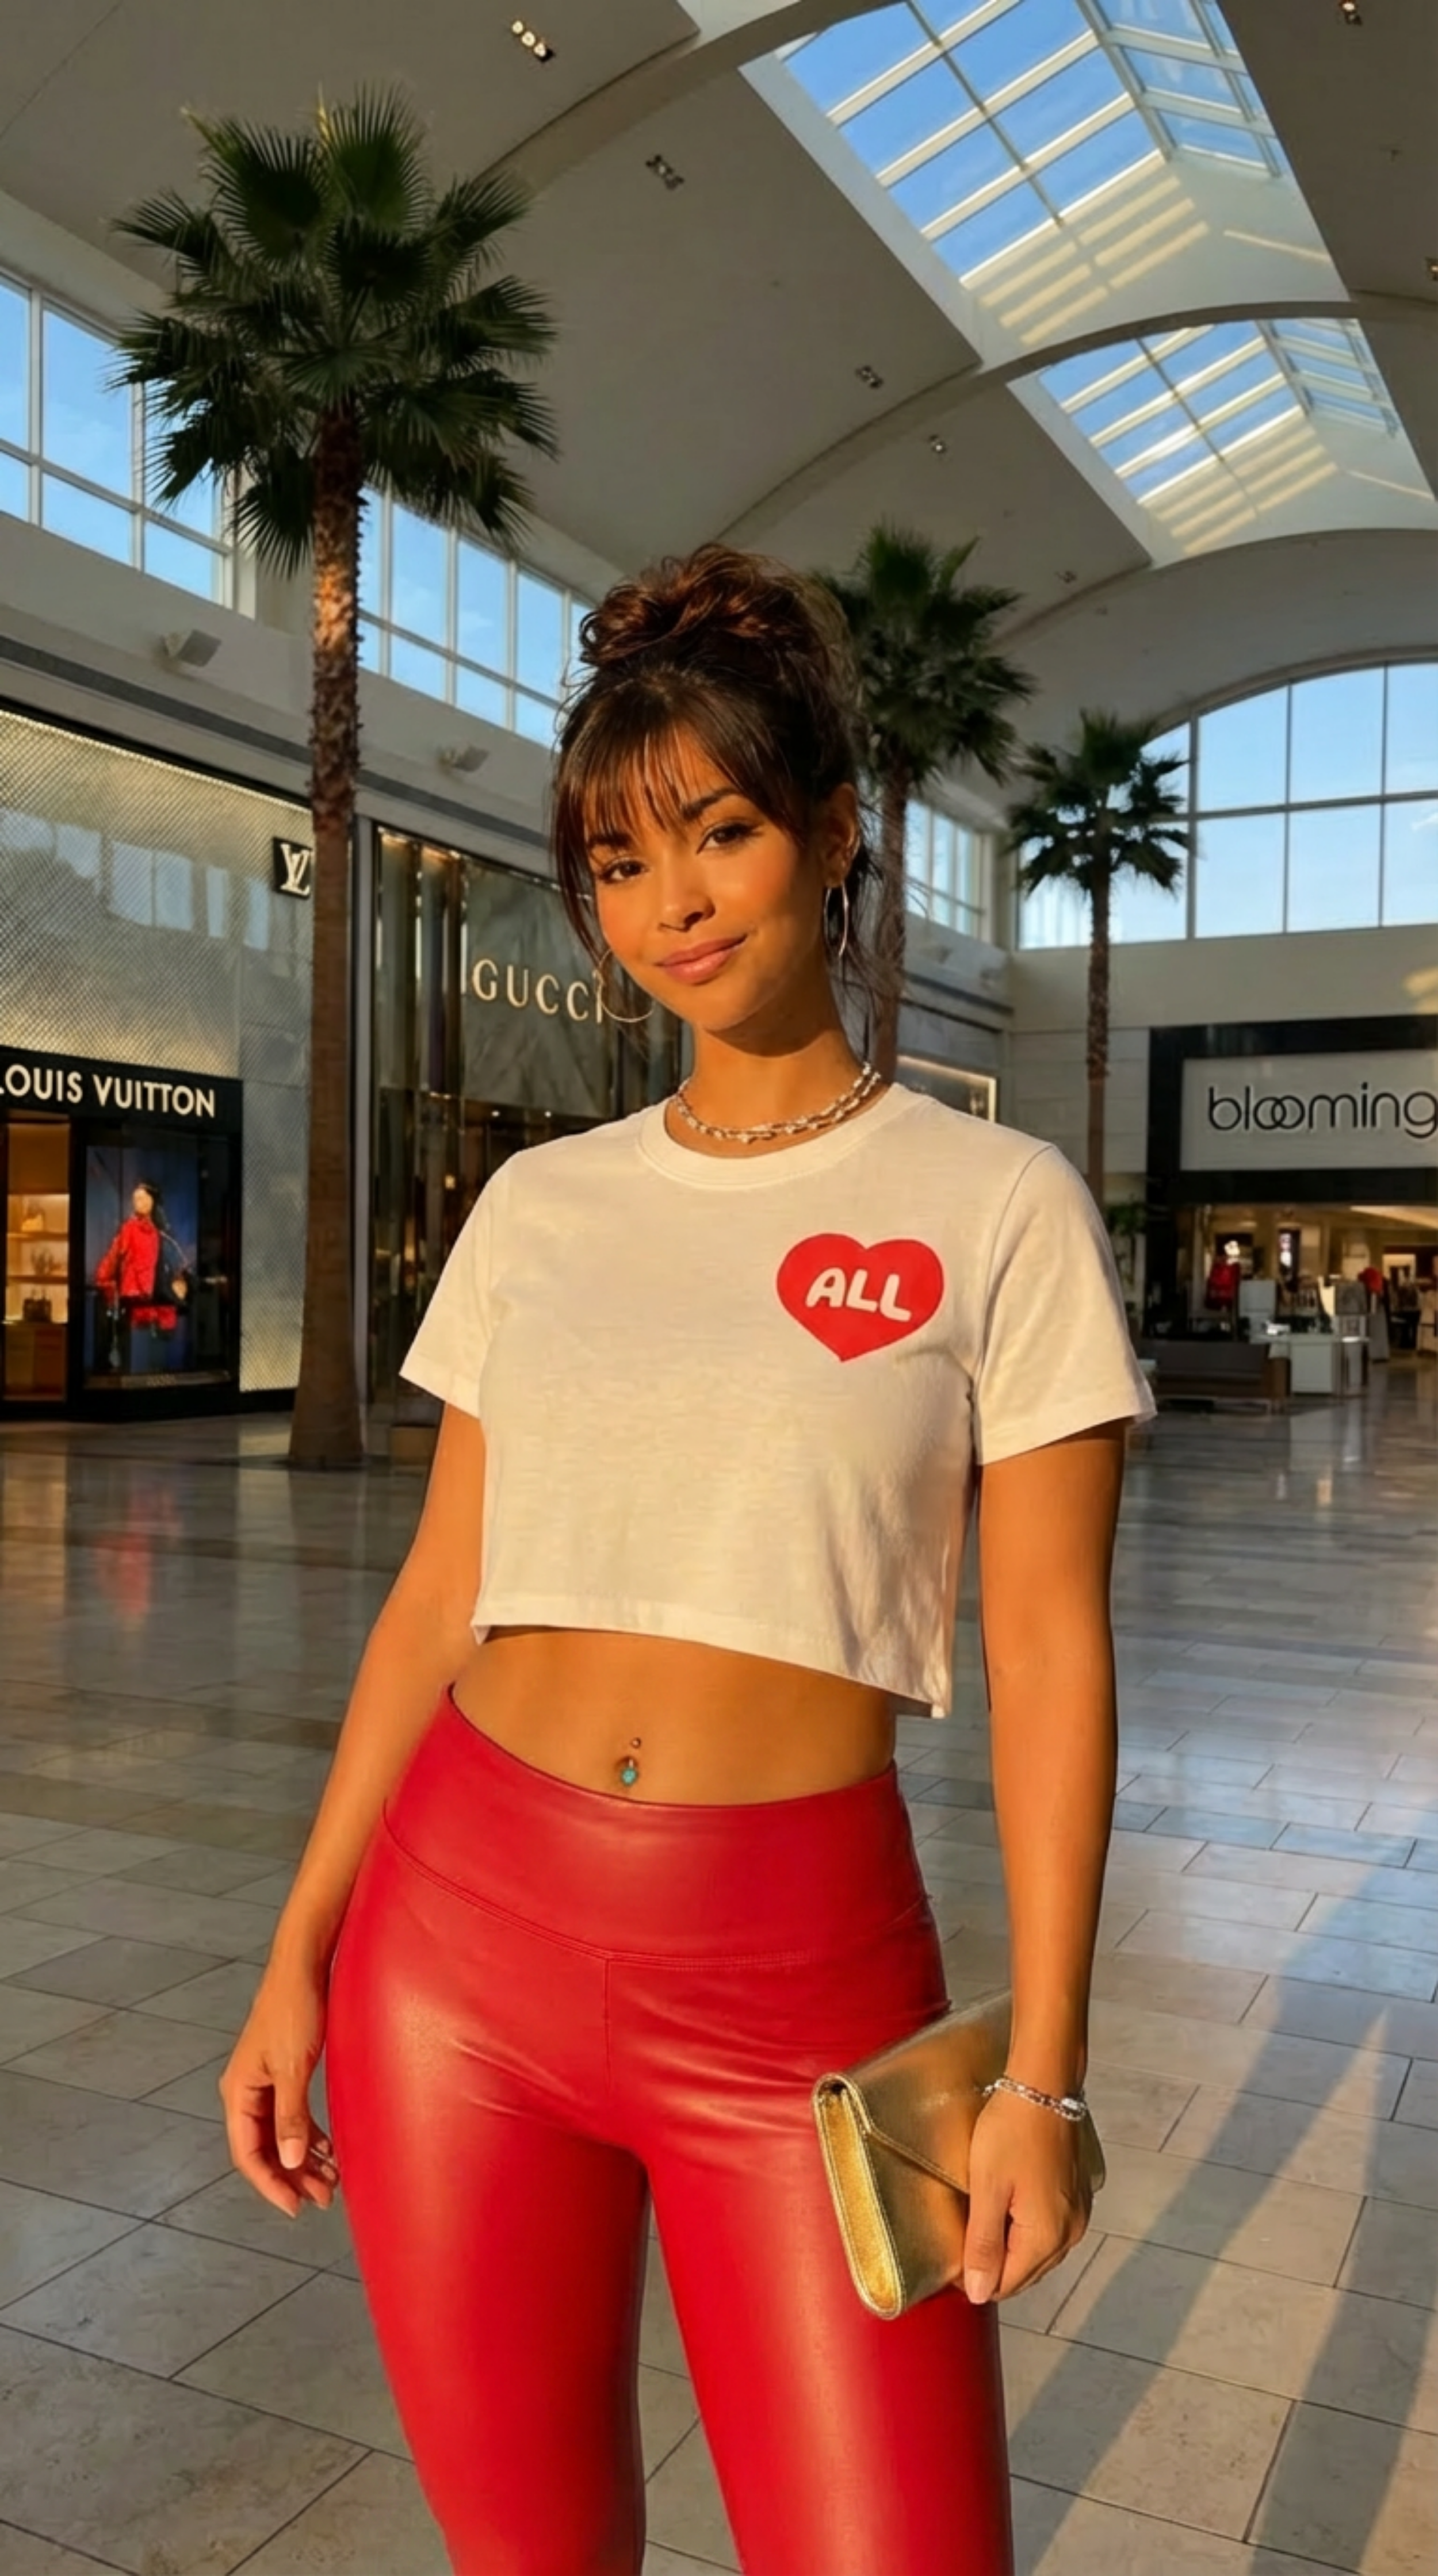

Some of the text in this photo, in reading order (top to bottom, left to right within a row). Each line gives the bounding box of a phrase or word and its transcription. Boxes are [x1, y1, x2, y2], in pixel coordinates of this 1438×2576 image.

[471, 959, 603, 1023] GUCCI
[0, 1064, 215, 1118] OUIS VUITTON
[1207, 1082, 1438, 1139] blooming
[805, 1267, 912, 1322] ALL
